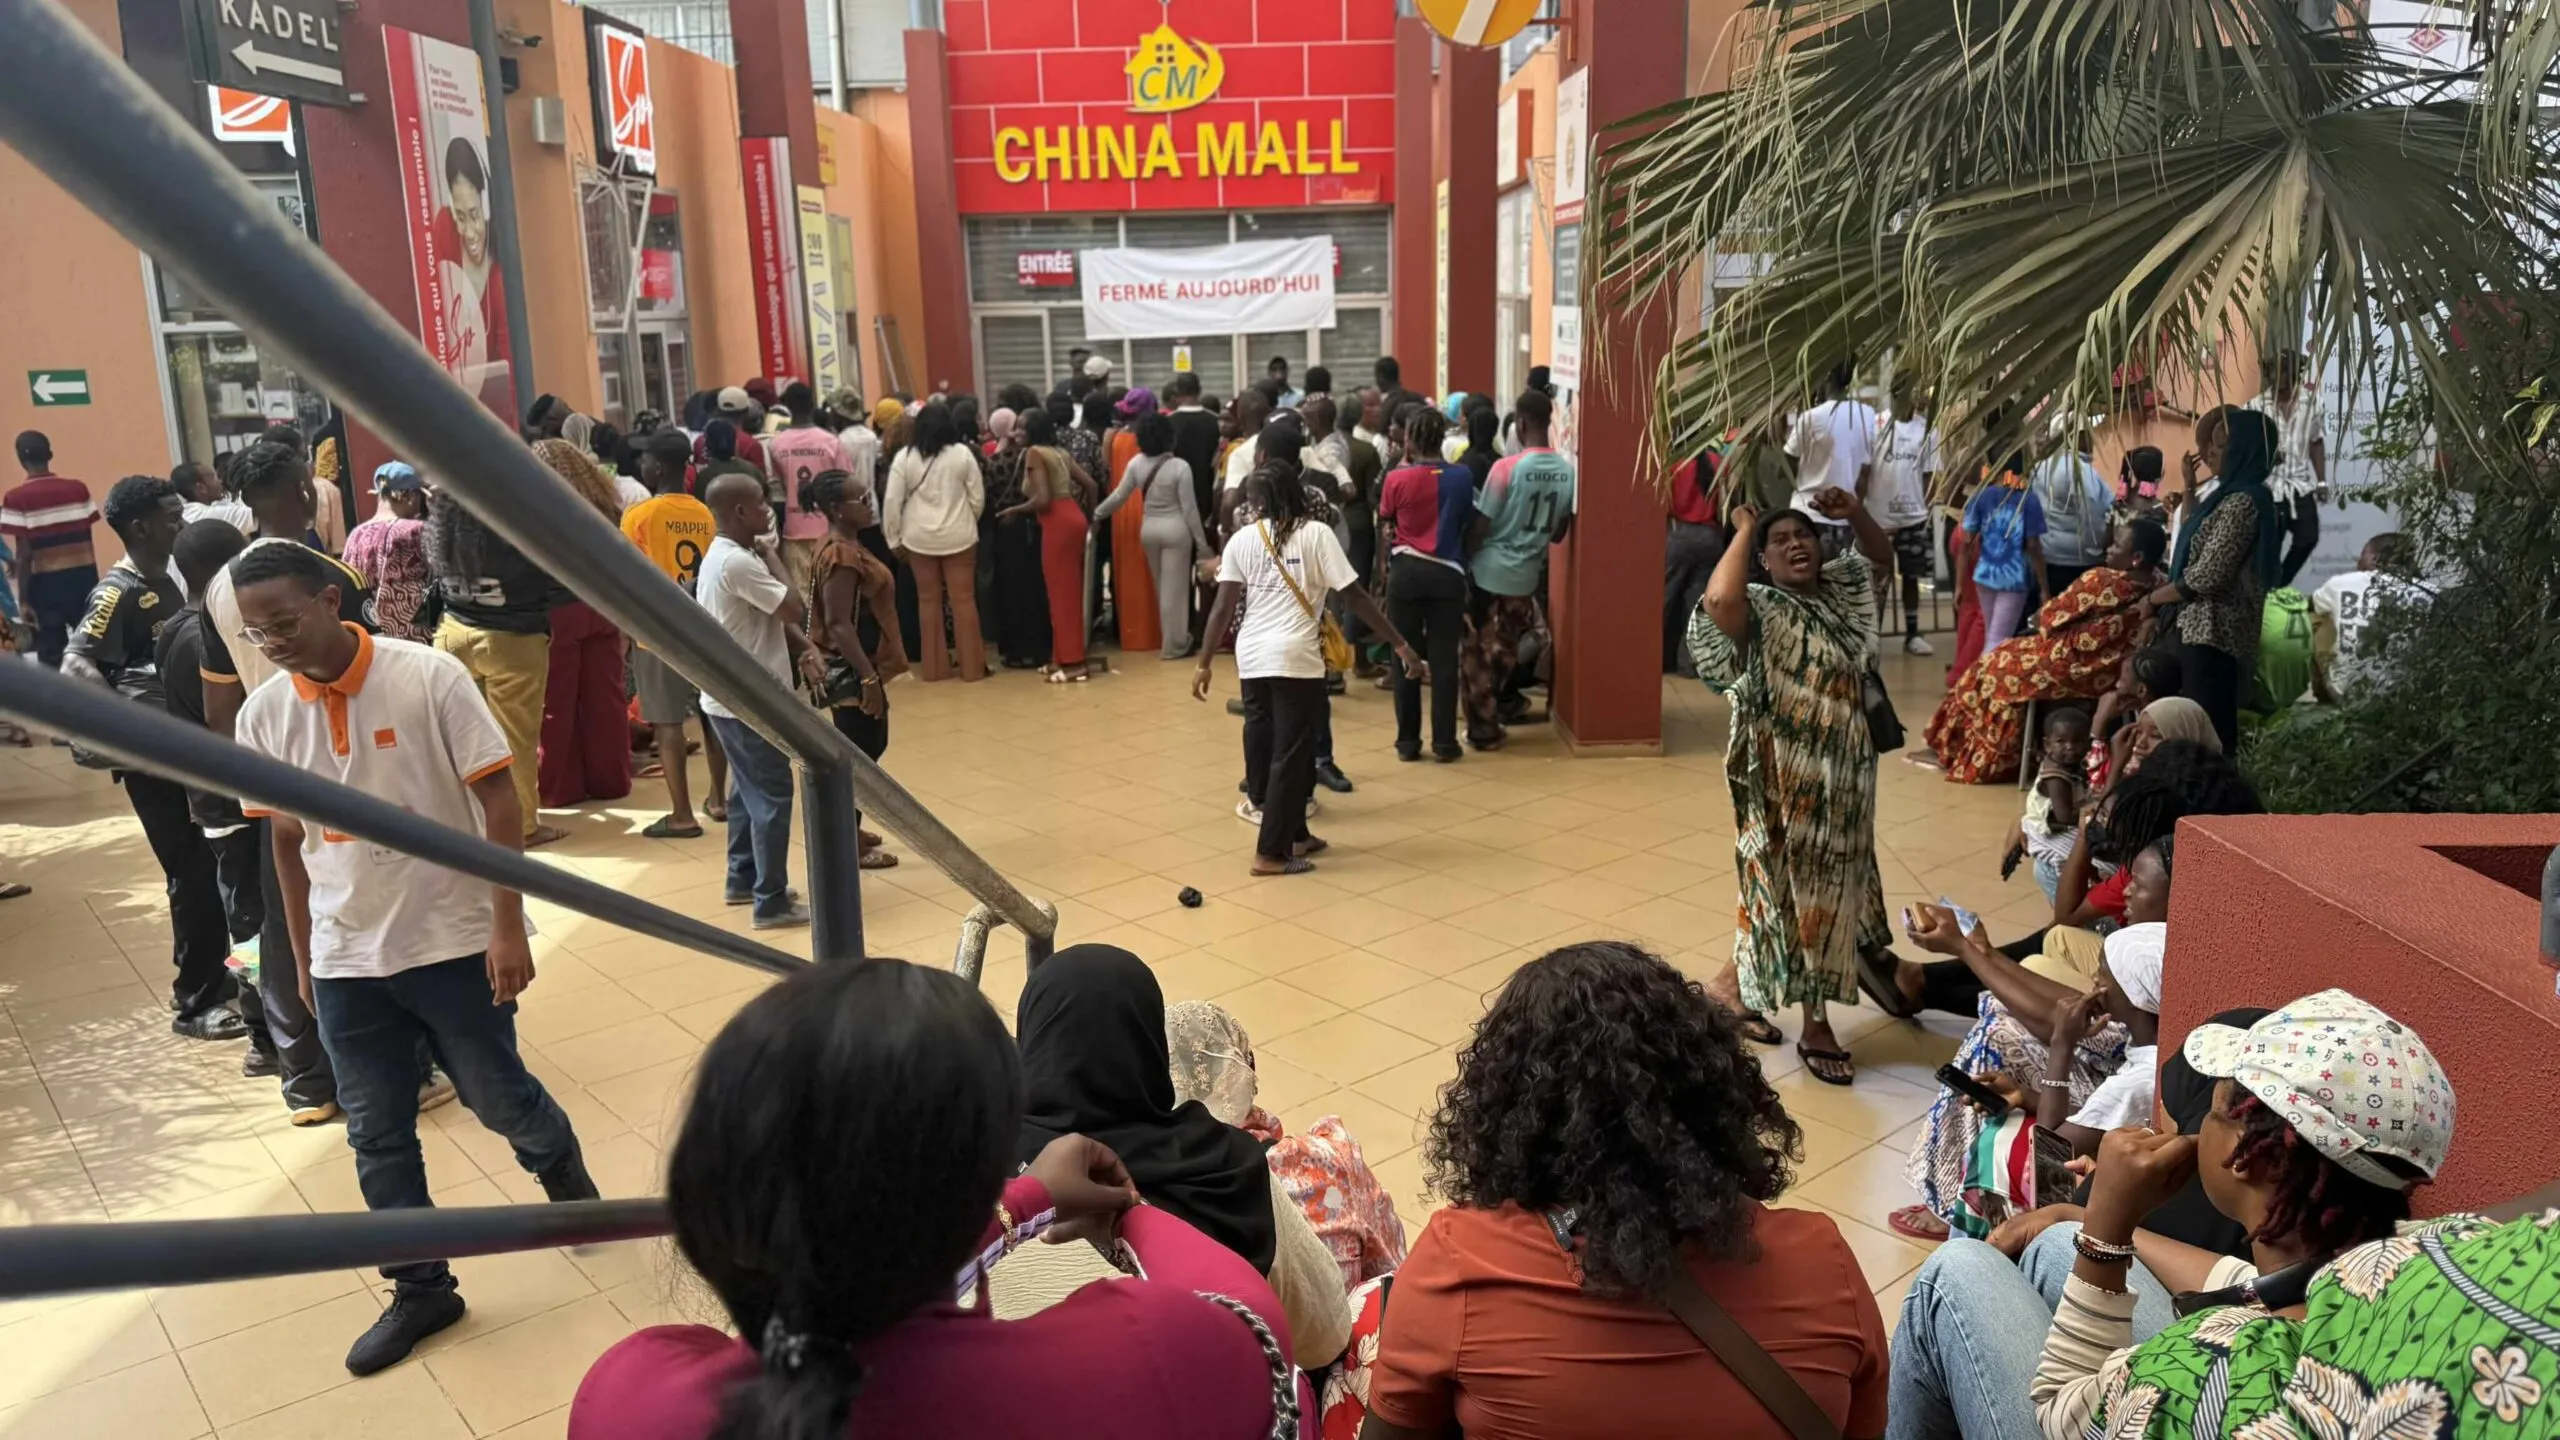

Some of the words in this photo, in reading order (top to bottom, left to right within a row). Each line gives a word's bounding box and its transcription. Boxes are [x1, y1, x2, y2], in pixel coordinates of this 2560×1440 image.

[220, 0, 339, 52] KADEL
[1139, 65, 1198, 103] CM
[993, 123, 1183, 183] CHINA
[1197, 119, 1360, 177] MALL
[411, 128, 431, 227] ressemble
[755, 162, 771, 228] ressemble
[424, 230, 438, 275] vous
[762, 227, 775, 262] vous
[1018, 250, 1073, 273] ENTRÉE
[766, 262, 777, 283] qui
[1099, 280, 1169, 303] FERMÉ
[1176, 274, 1321, 299] AUJOURD'HUI
[430, 276, 442, 311] qui
[767, 284, 784, 355] technologie
[774, 355, 785, 373] La
[1526, 472, 1568, 482] CHOCO
[1522, 490, 1558, 533] 11
